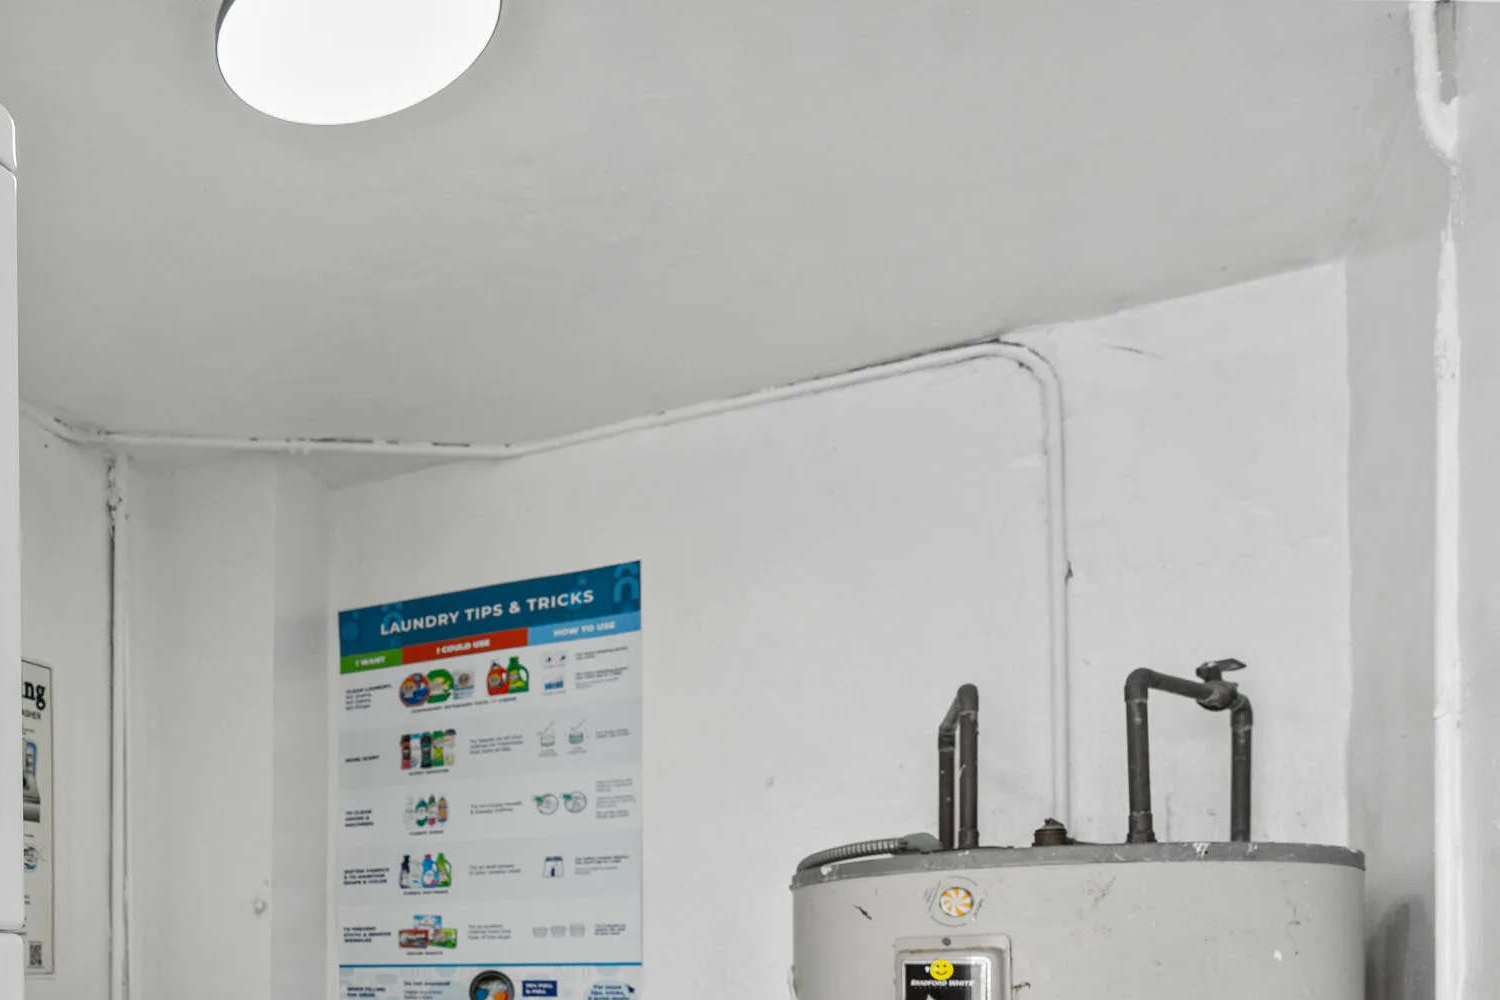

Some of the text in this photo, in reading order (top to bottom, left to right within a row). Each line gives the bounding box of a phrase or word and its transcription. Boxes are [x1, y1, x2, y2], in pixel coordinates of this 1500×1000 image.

[380, 588, 594, 636] LAUNDRY TIPS & TRICKS
[553, 620, 615, 637] HOW TO USE
[441, 641, 470, 653] COULD
[473, 638, 490, 649] USE
[360, 655, 385, 666] WANT
